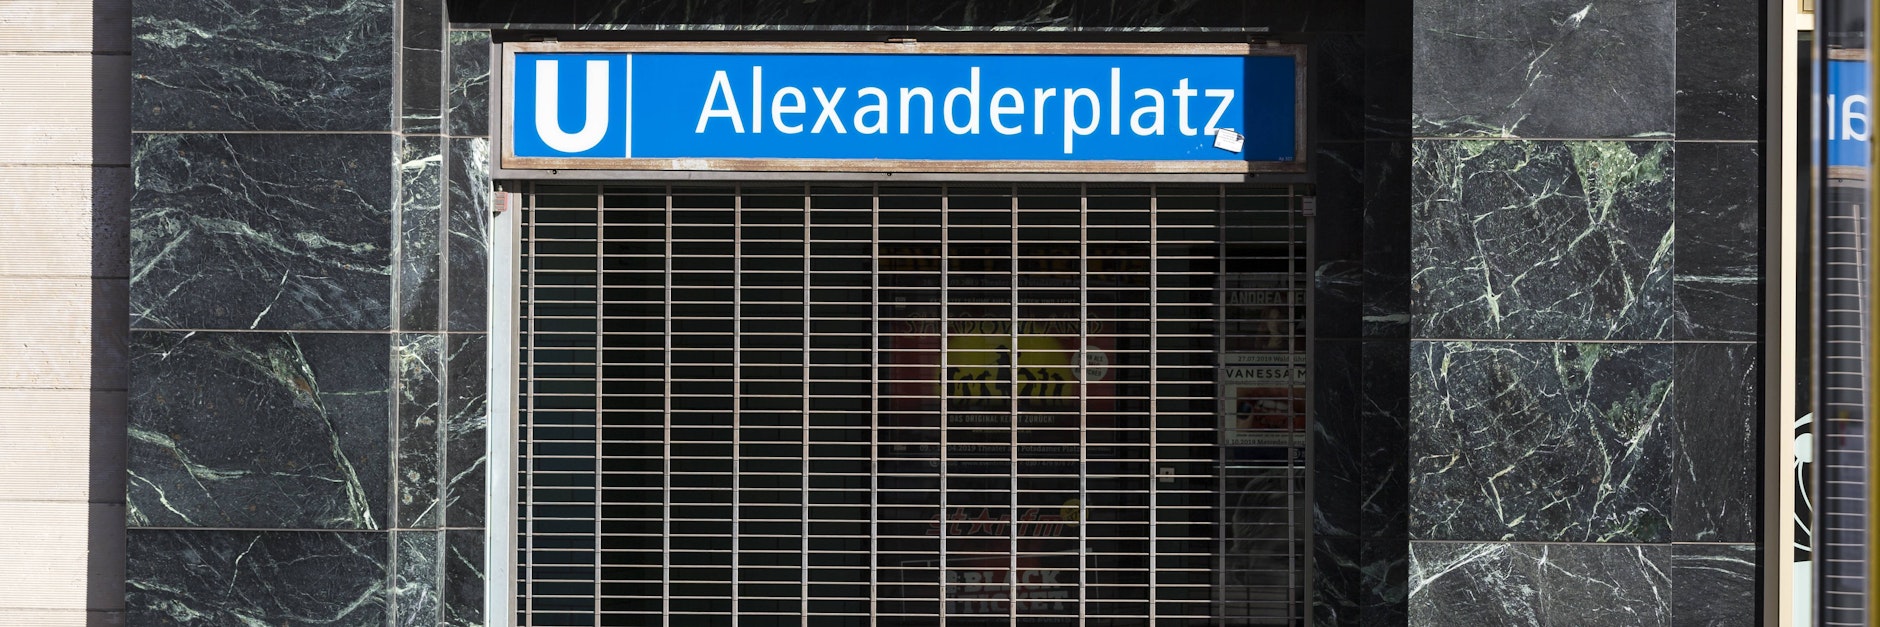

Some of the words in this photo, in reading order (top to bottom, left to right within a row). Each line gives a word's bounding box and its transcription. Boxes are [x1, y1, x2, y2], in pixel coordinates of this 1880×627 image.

[535, 60, 609, 152] U
[695, 67, 1236, 154] Alexanderplatz
[1230, 291, 1282, 304] ANDREA
[1226, 369, 1289, 379] VANESSA
[949, 414, 964, 424] DAS
[965, 414, 998, 424] ORIGINAL
[1000, 414, 1022, 424] KET
[963, 570, 1059, 592] BLACK
[961, 591, 1068, 614] TICKET
